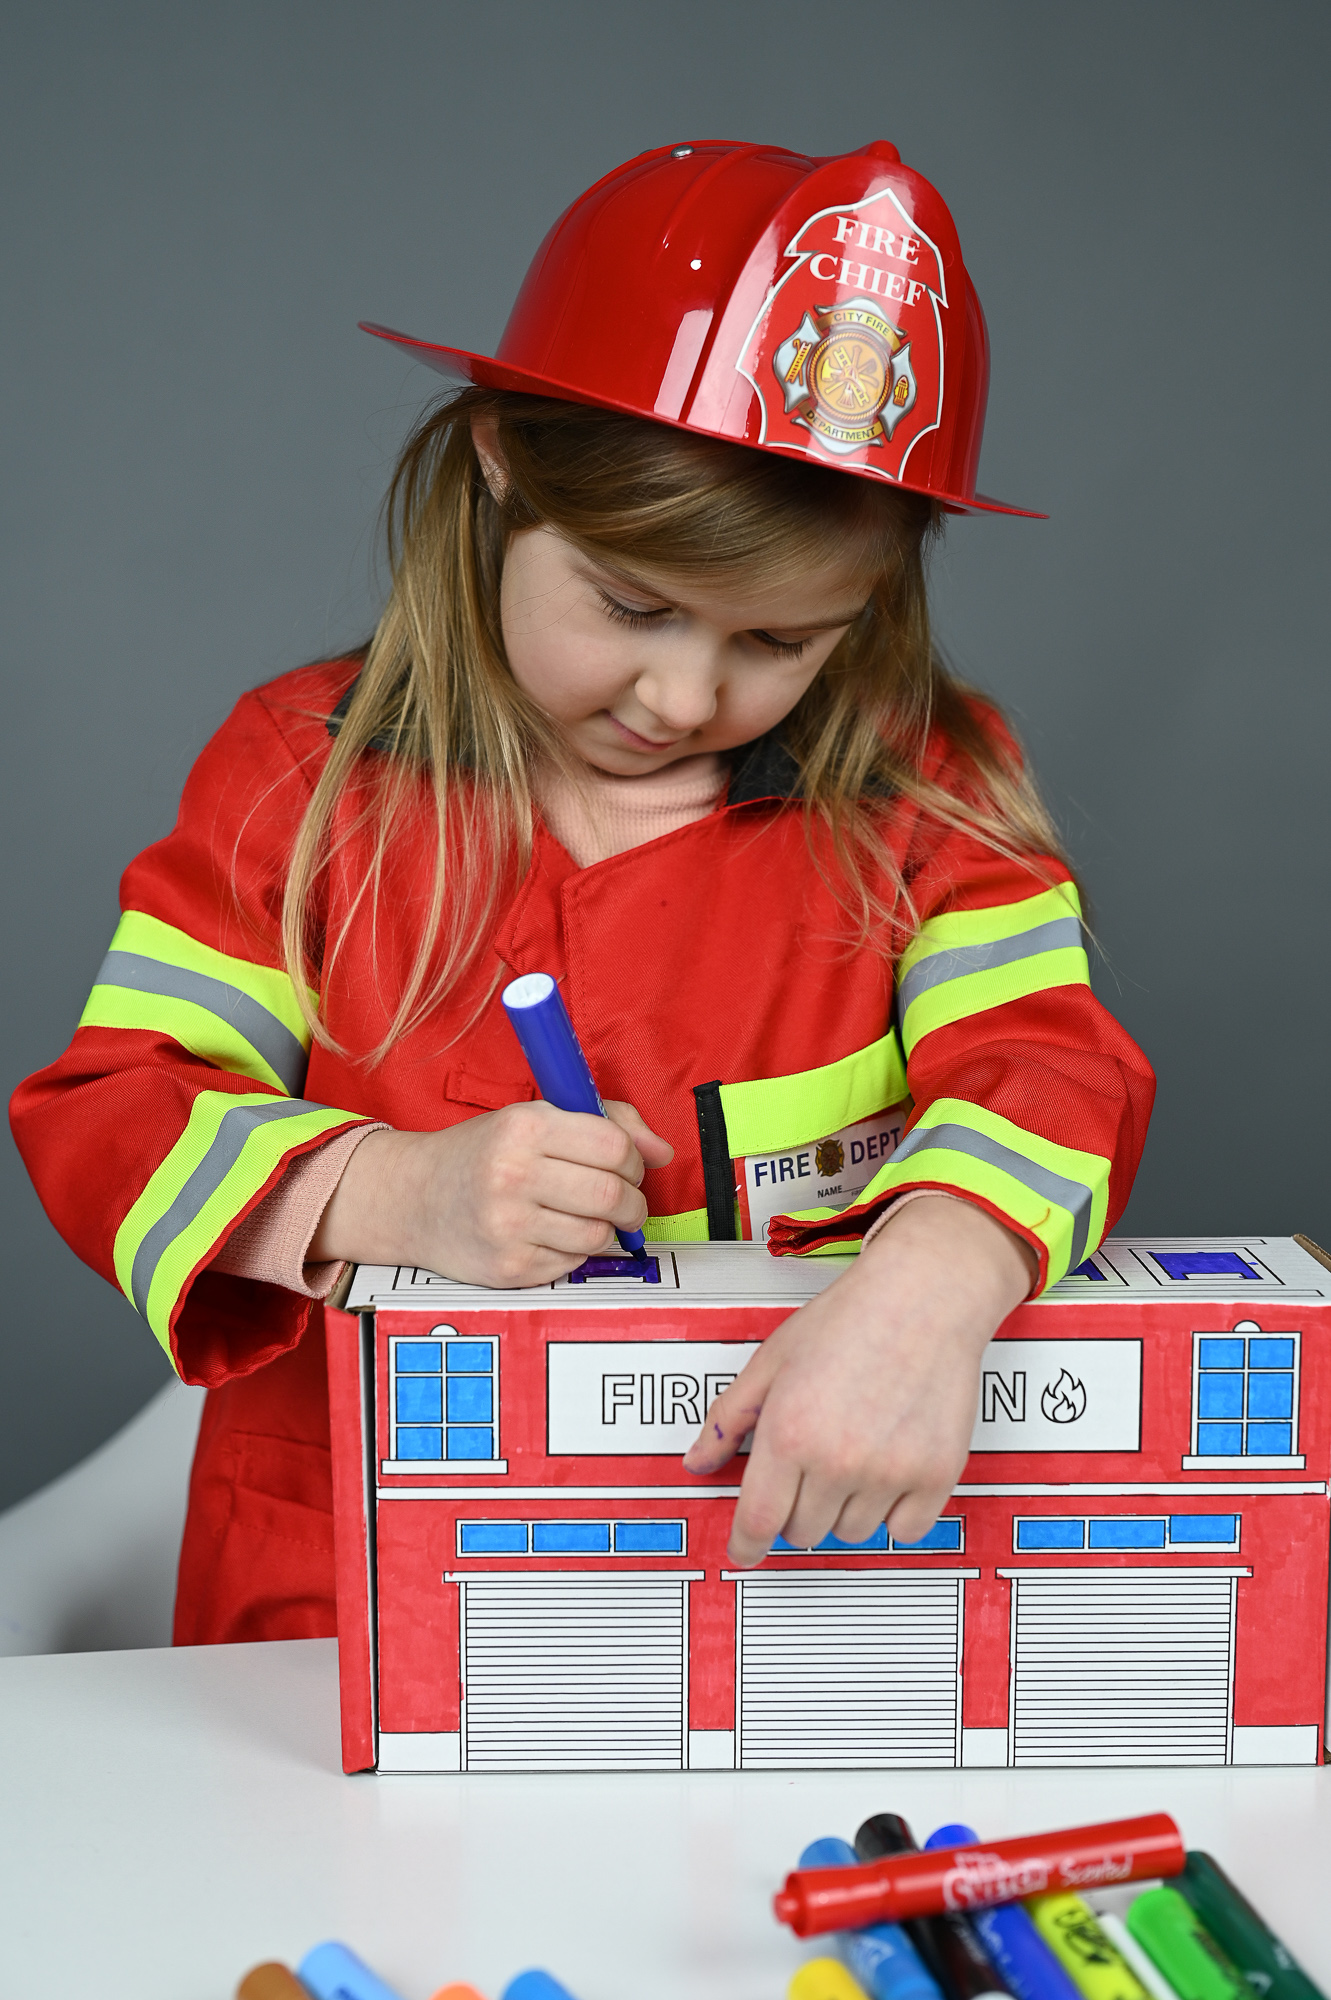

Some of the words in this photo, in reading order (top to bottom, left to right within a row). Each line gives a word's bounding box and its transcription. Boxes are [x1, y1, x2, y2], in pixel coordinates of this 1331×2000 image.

[832, 216, 921, 265] FIRE
[809, 253, 926, 307] CHIEF
[833, 312, 863, 324] CITY
[866, 315, 891, 337] FIRE
[805, 409, 876, 440] DEPARTMENT
[754, 1152, 811, 1187] FIRE
[850, 1127, 901, 1165] DEPT
[817, 1185, 843, 1199] NAME
